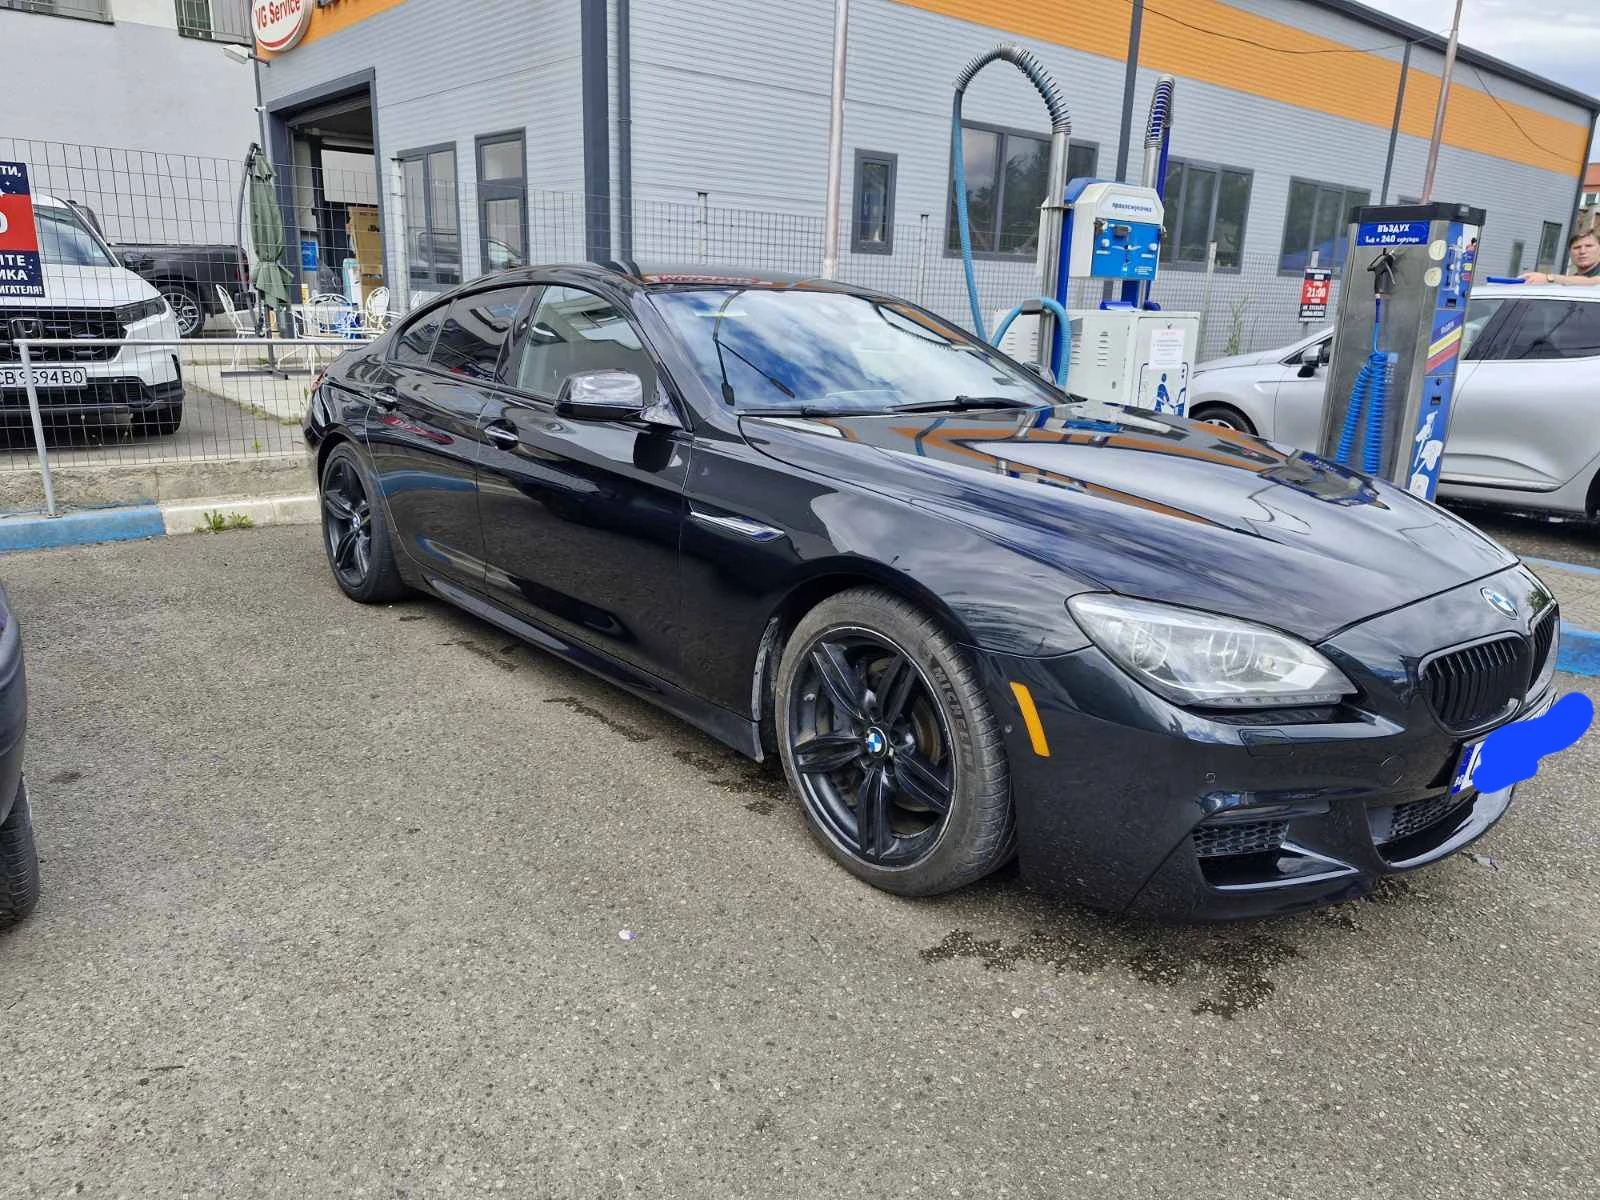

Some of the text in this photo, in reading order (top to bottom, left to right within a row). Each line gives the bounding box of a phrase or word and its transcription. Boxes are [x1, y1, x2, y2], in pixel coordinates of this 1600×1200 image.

[255, 0, 301, 30] VG Service
[1377, 223, 1410, 233] ВЪЗДУХ
[1381, 234, 1396, 243] 240
